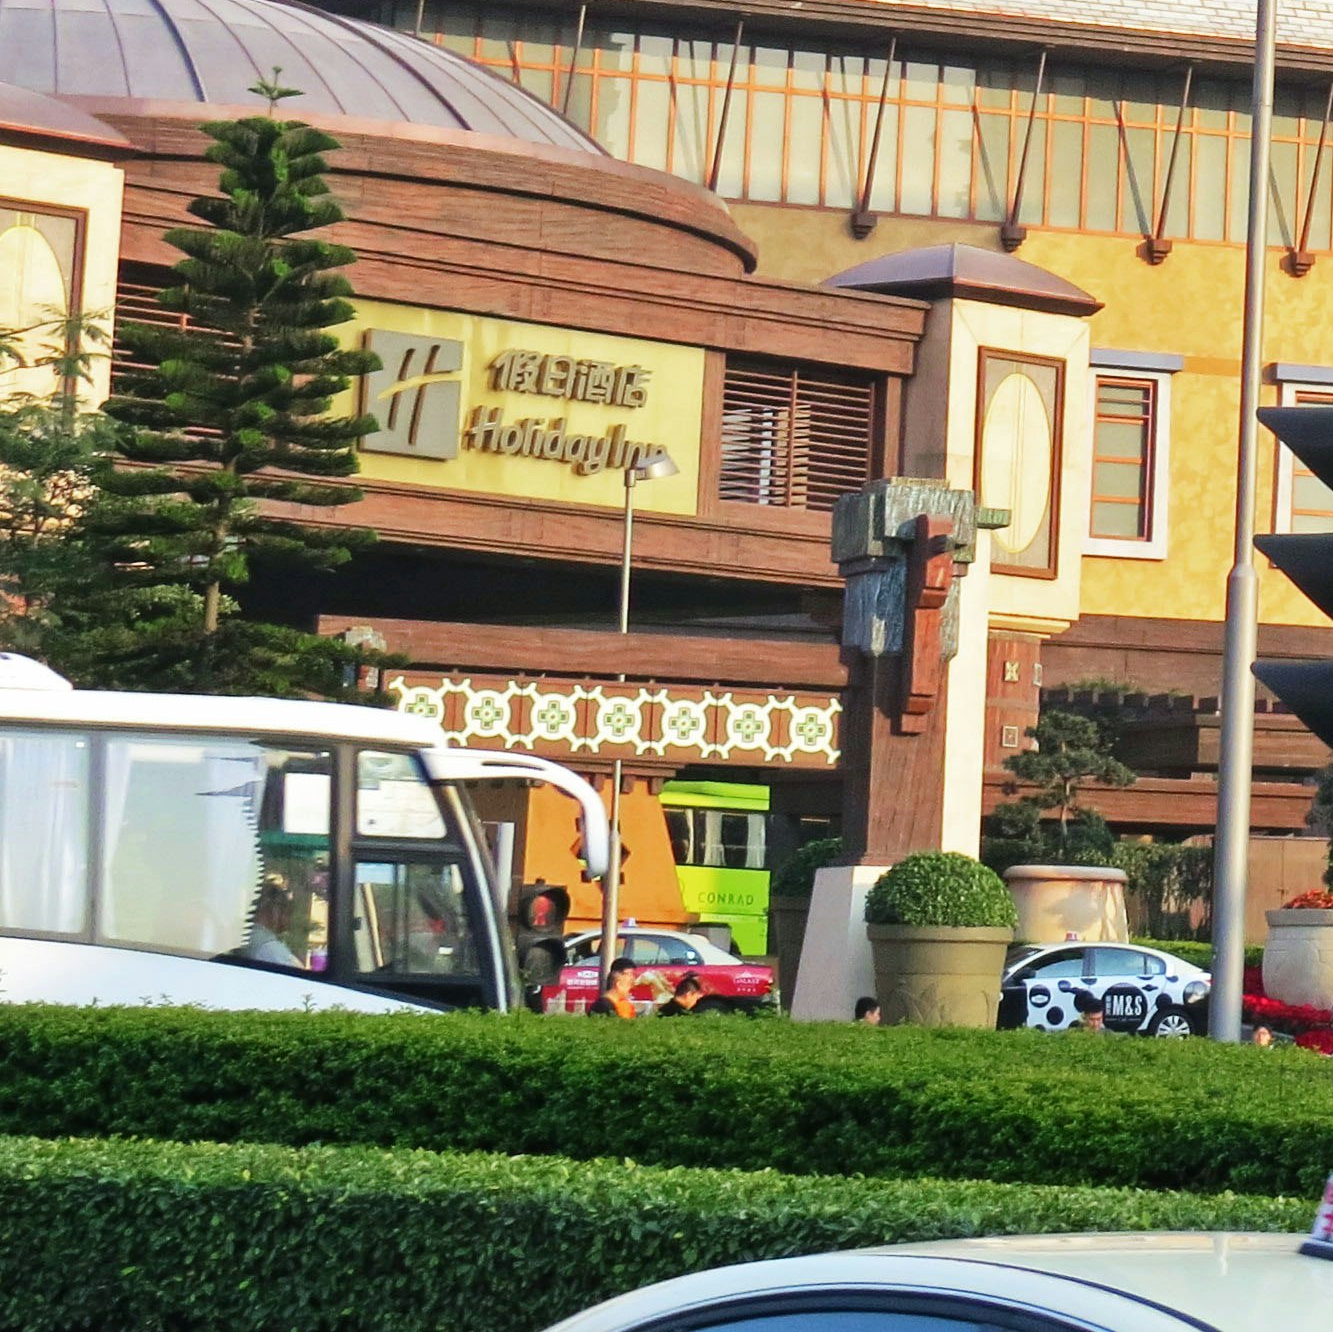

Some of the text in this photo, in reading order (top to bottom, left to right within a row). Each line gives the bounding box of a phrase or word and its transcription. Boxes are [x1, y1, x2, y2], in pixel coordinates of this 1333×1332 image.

[488, 349, 653, 408] 假日酒店
[463, 405, 611, 476] Holiday
[698, 891, 754, 906] CONRAD
[1112, 995, 1143, 1016] M&S
